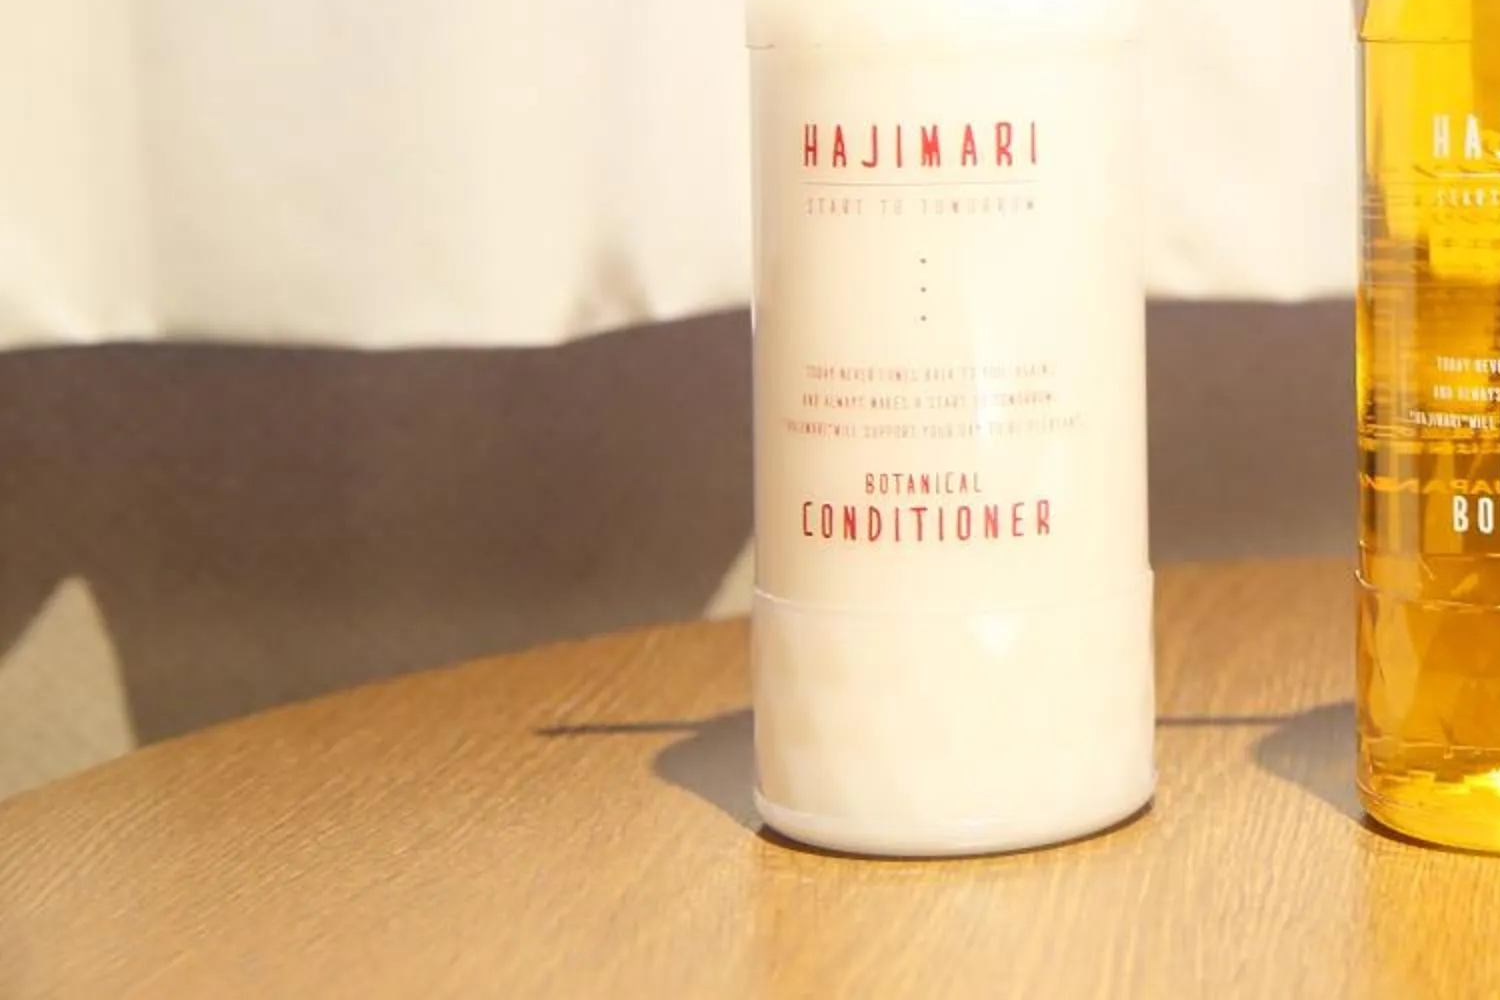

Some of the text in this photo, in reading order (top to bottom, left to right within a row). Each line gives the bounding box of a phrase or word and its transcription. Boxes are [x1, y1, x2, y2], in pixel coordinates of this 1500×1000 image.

[803, 120, 1037, 168] HAJIMARI
[865, 471, 982, 495] BOTANICAL
[802, 499, 1050, 542] CONDITIONER
